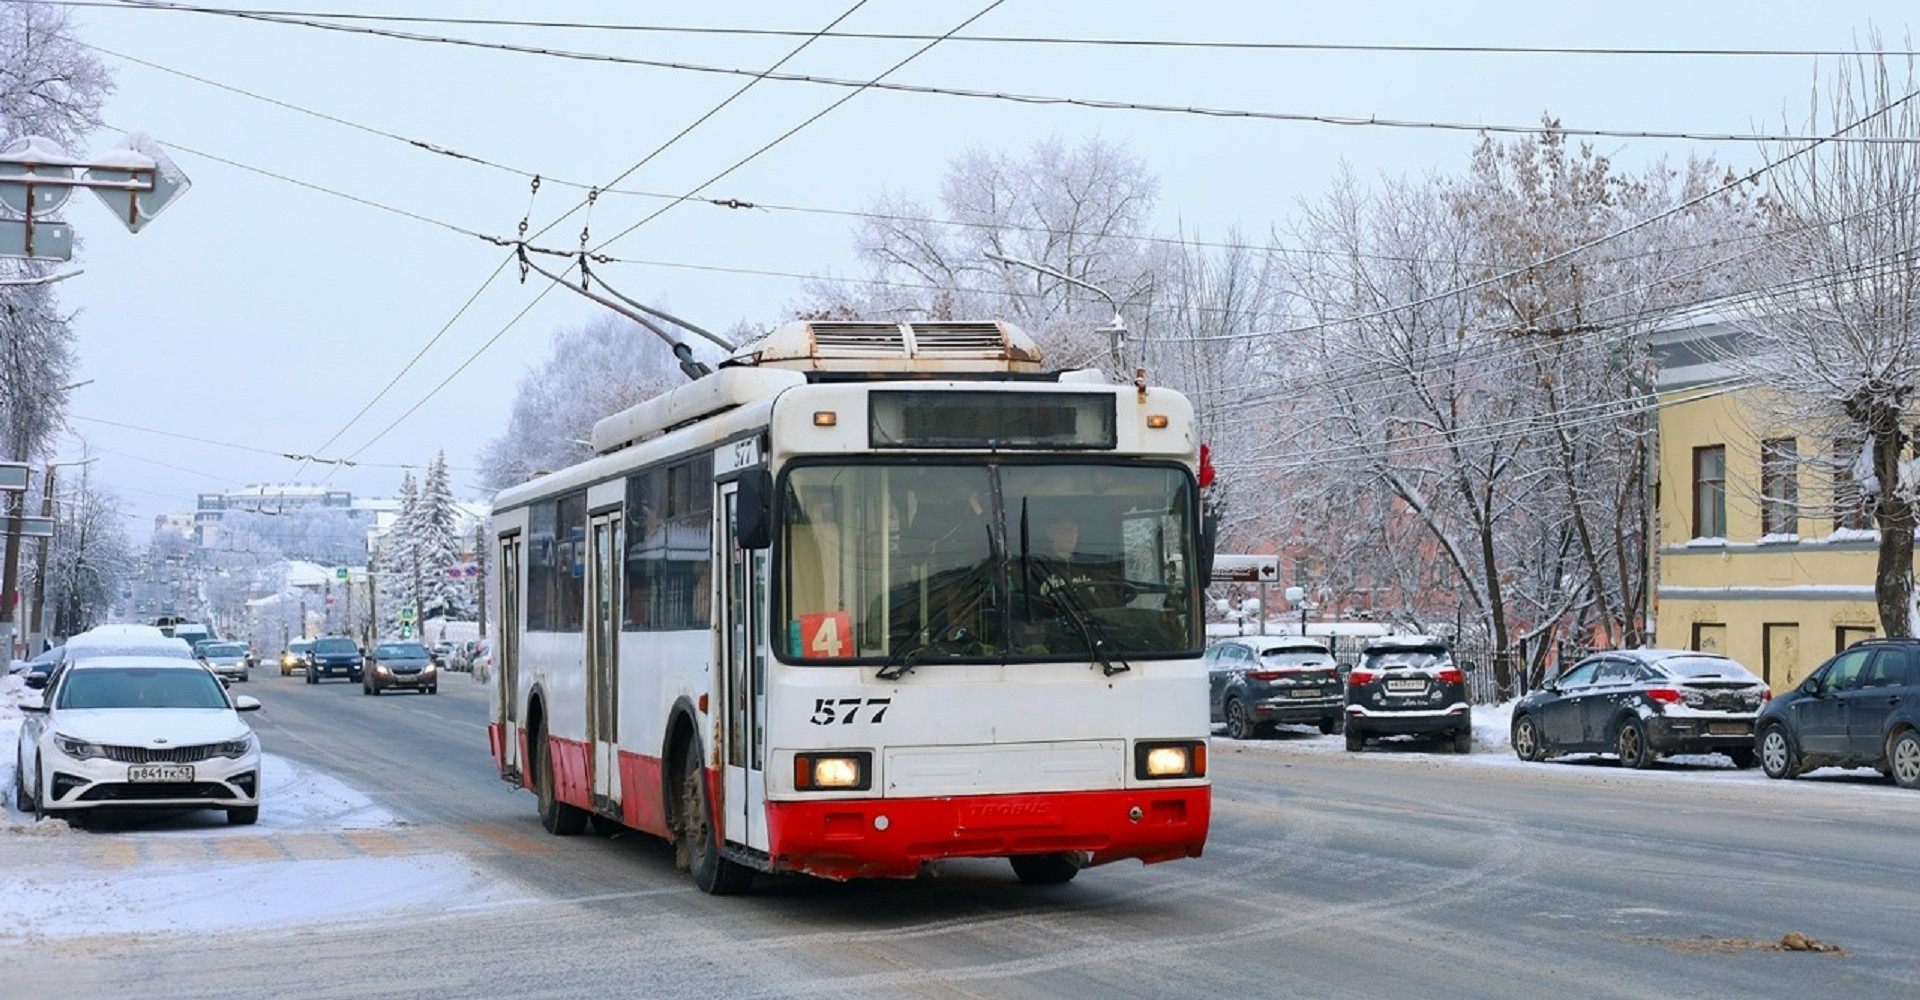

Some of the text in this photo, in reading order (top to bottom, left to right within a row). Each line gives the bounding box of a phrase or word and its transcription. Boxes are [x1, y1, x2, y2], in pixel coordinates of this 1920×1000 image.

[734, 440, 752, 468] 577
[811, 617, 843, 657] 4
[810, 698, 892, 726] 577
